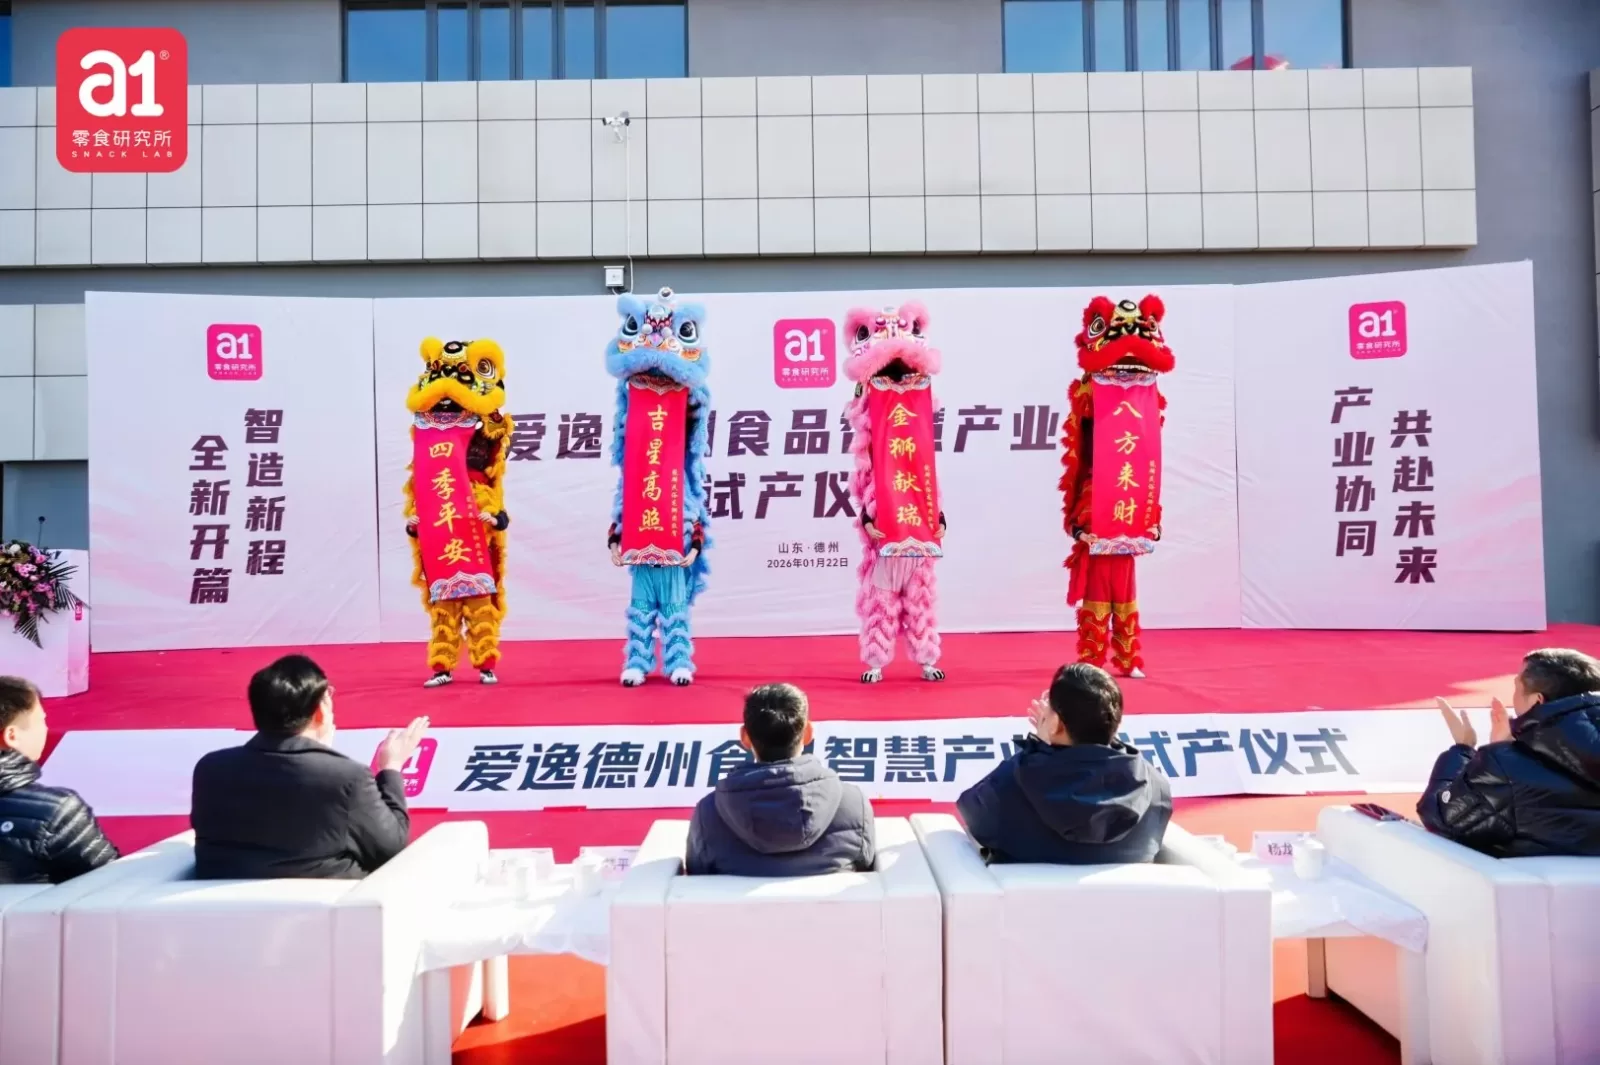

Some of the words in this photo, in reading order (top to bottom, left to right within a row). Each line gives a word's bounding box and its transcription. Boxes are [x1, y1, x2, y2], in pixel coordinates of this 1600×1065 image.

[216, 332, 253, 359] a1
[781, 366, 829, 376] 零食研究所
[784, 328, 825, 362] a1
[1358, 309, 1397, 338] a1
[189, 435, 232, 604] 全新开篇
[244, 408, 286, 576] 智造新程
[428, 441, 473, 566] 四季平安
[638, 403, 669, 533] 吉星高照
[887, 402, 924, 528] 金狮献瑞
[1112, 400, 1143, 526] 八方来财
[1331, 386, 1377, 557] 产业协同
[1390, 409, 1438, 584] 共赴未来
[767, 557, 848, 568] 2026年01月22日
